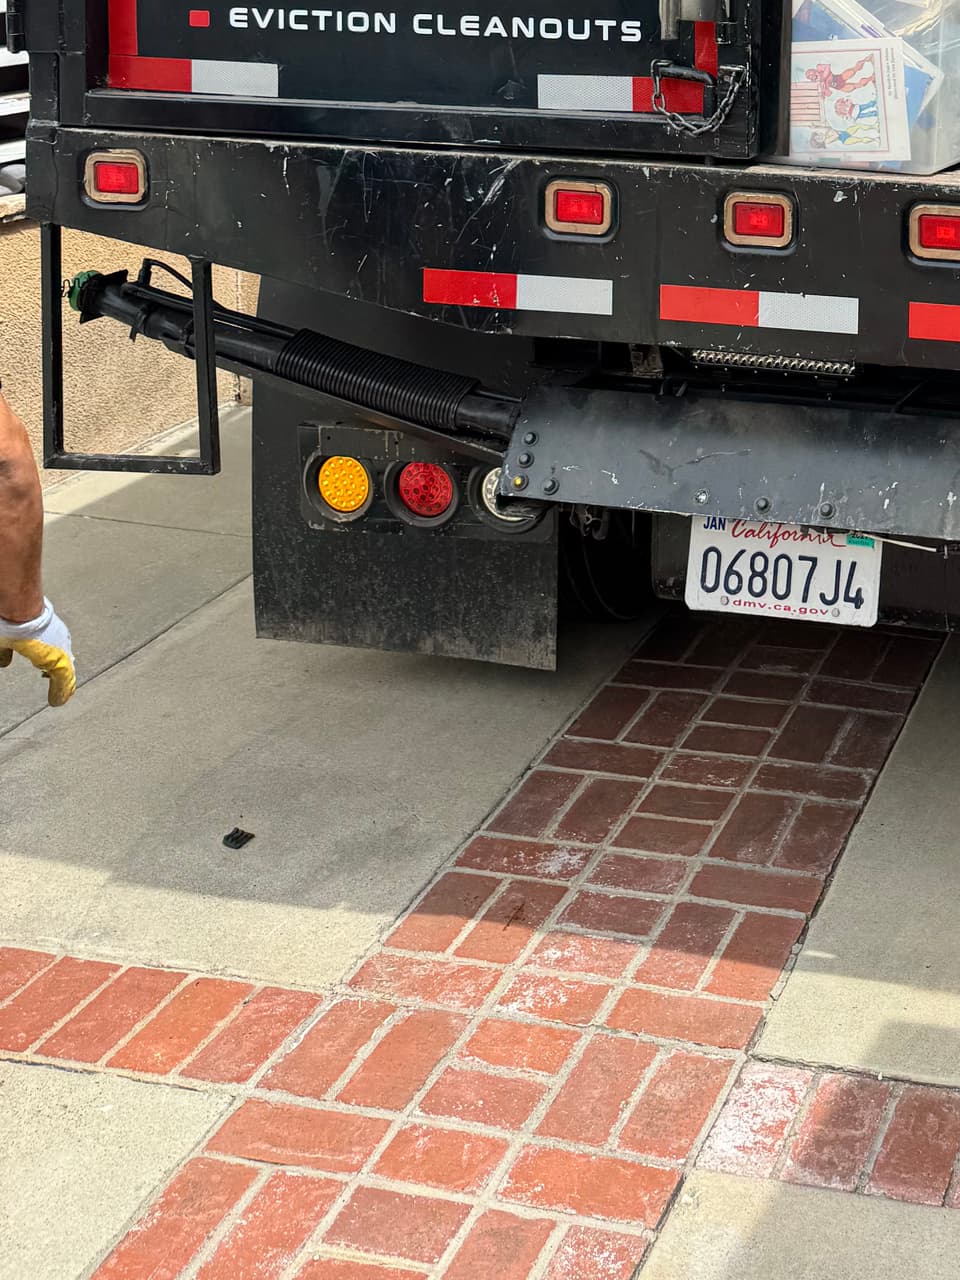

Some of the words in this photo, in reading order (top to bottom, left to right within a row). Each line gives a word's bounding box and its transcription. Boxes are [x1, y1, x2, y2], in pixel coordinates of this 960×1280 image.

[228, 7, 396, 33] EVICTION
[412, 12, 642, 42] CLEANOUTS
[703, 516, 727, 531] JAN
[731, 520, 847, 549] California
[700, 545, 865, 610] 06807J4
[732, 598, 829, 617] dmv.ca.gov
